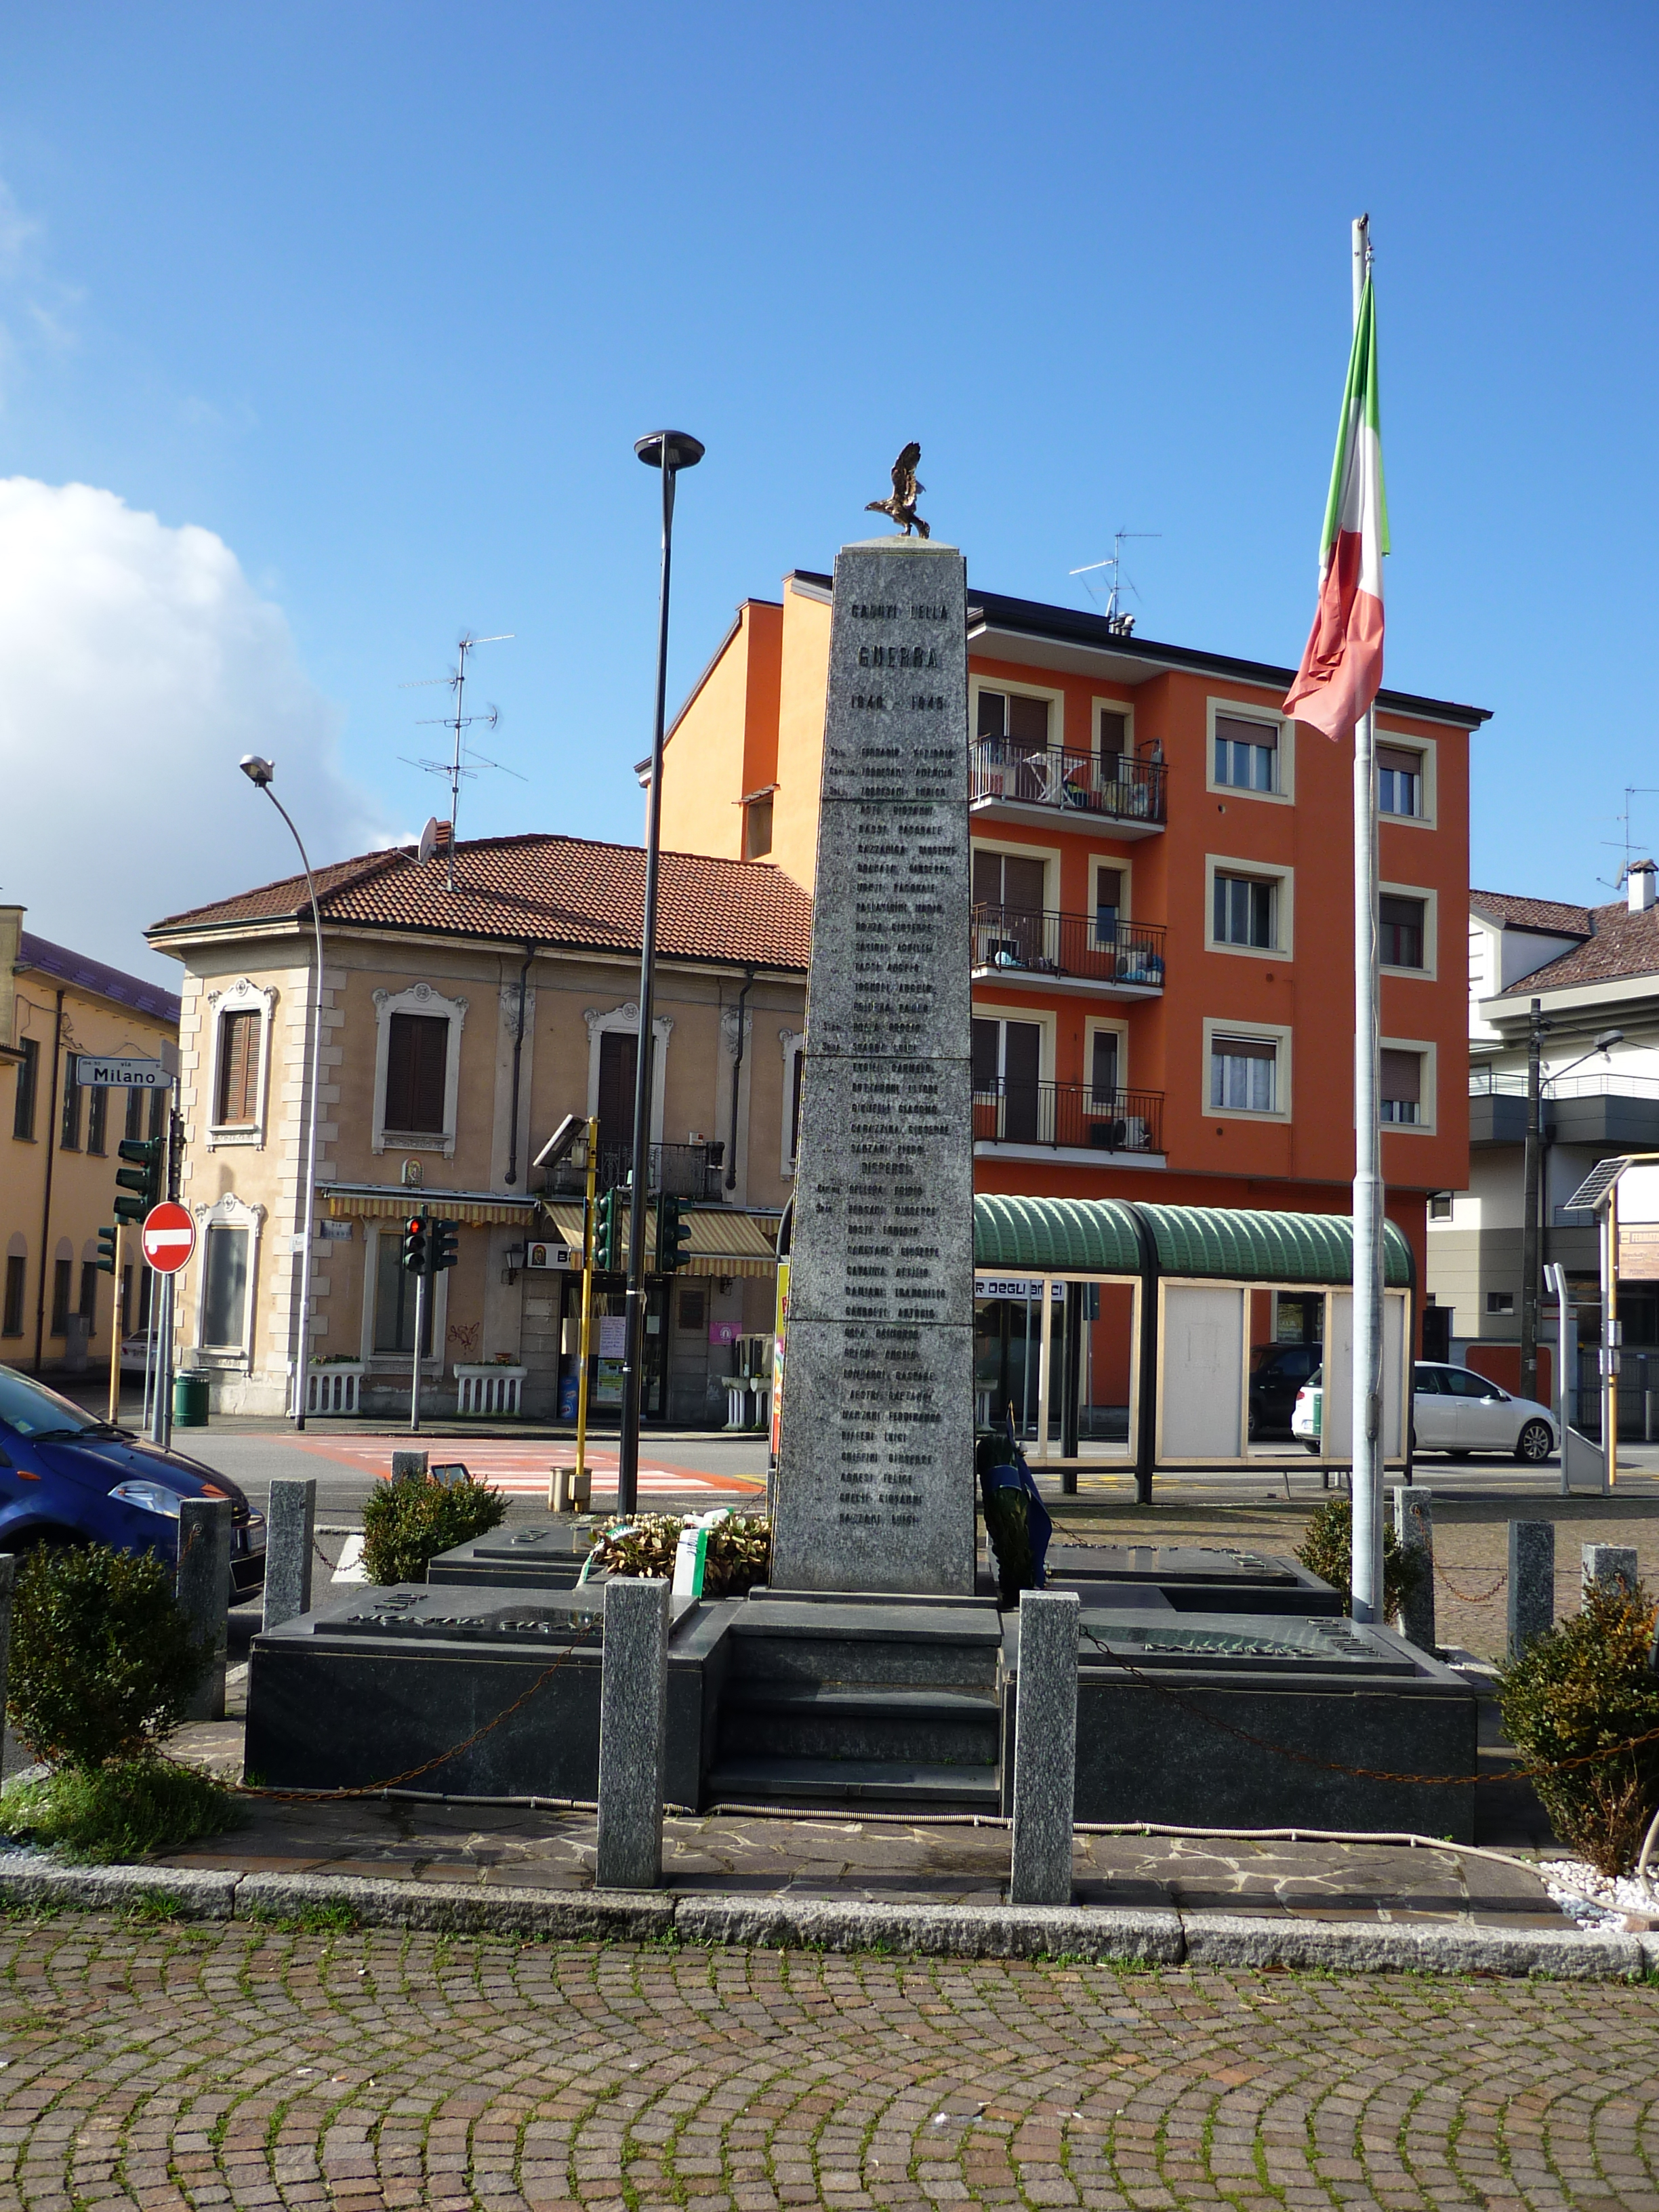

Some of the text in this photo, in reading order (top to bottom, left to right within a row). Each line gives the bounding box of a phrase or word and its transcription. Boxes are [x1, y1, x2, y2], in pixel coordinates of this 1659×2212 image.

[851, 605, 947, 619] CADUTI DELLA
[858, 646, 937, 668] GUERRA
[912, 696, 944, 710] 1945
[94, 1068, 155, 1084] Milano
